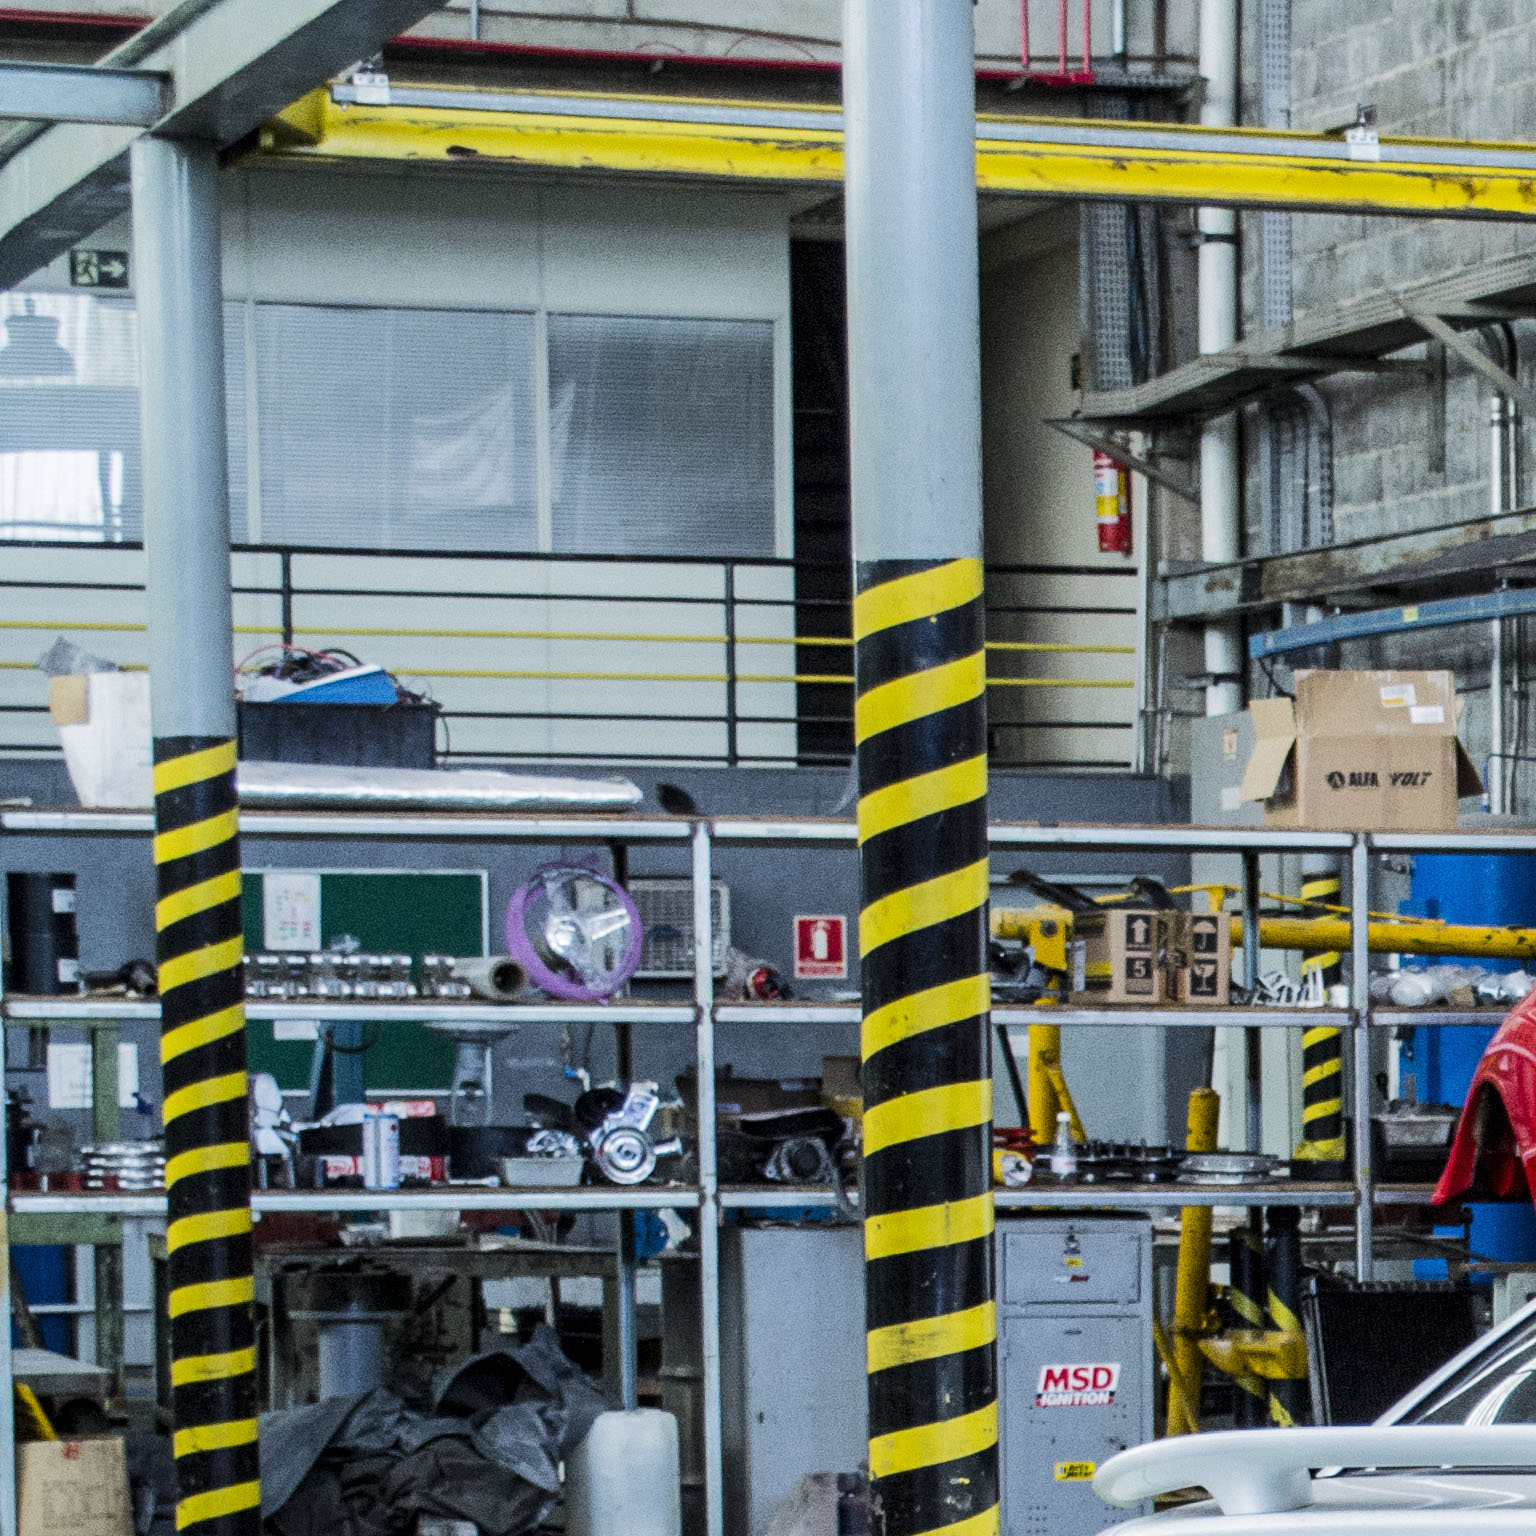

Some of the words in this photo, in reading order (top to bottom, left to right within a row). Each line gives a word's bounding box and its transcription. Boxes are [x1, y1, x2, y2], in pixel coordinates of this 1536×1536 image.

[1349, 771, 1379, 788] ALFA
[1389, 770, 1433, 787] VOLT
[1043, 1366, 1114, 1392] MSD
[1041, 1391, 1110, 1406] IGNITION
